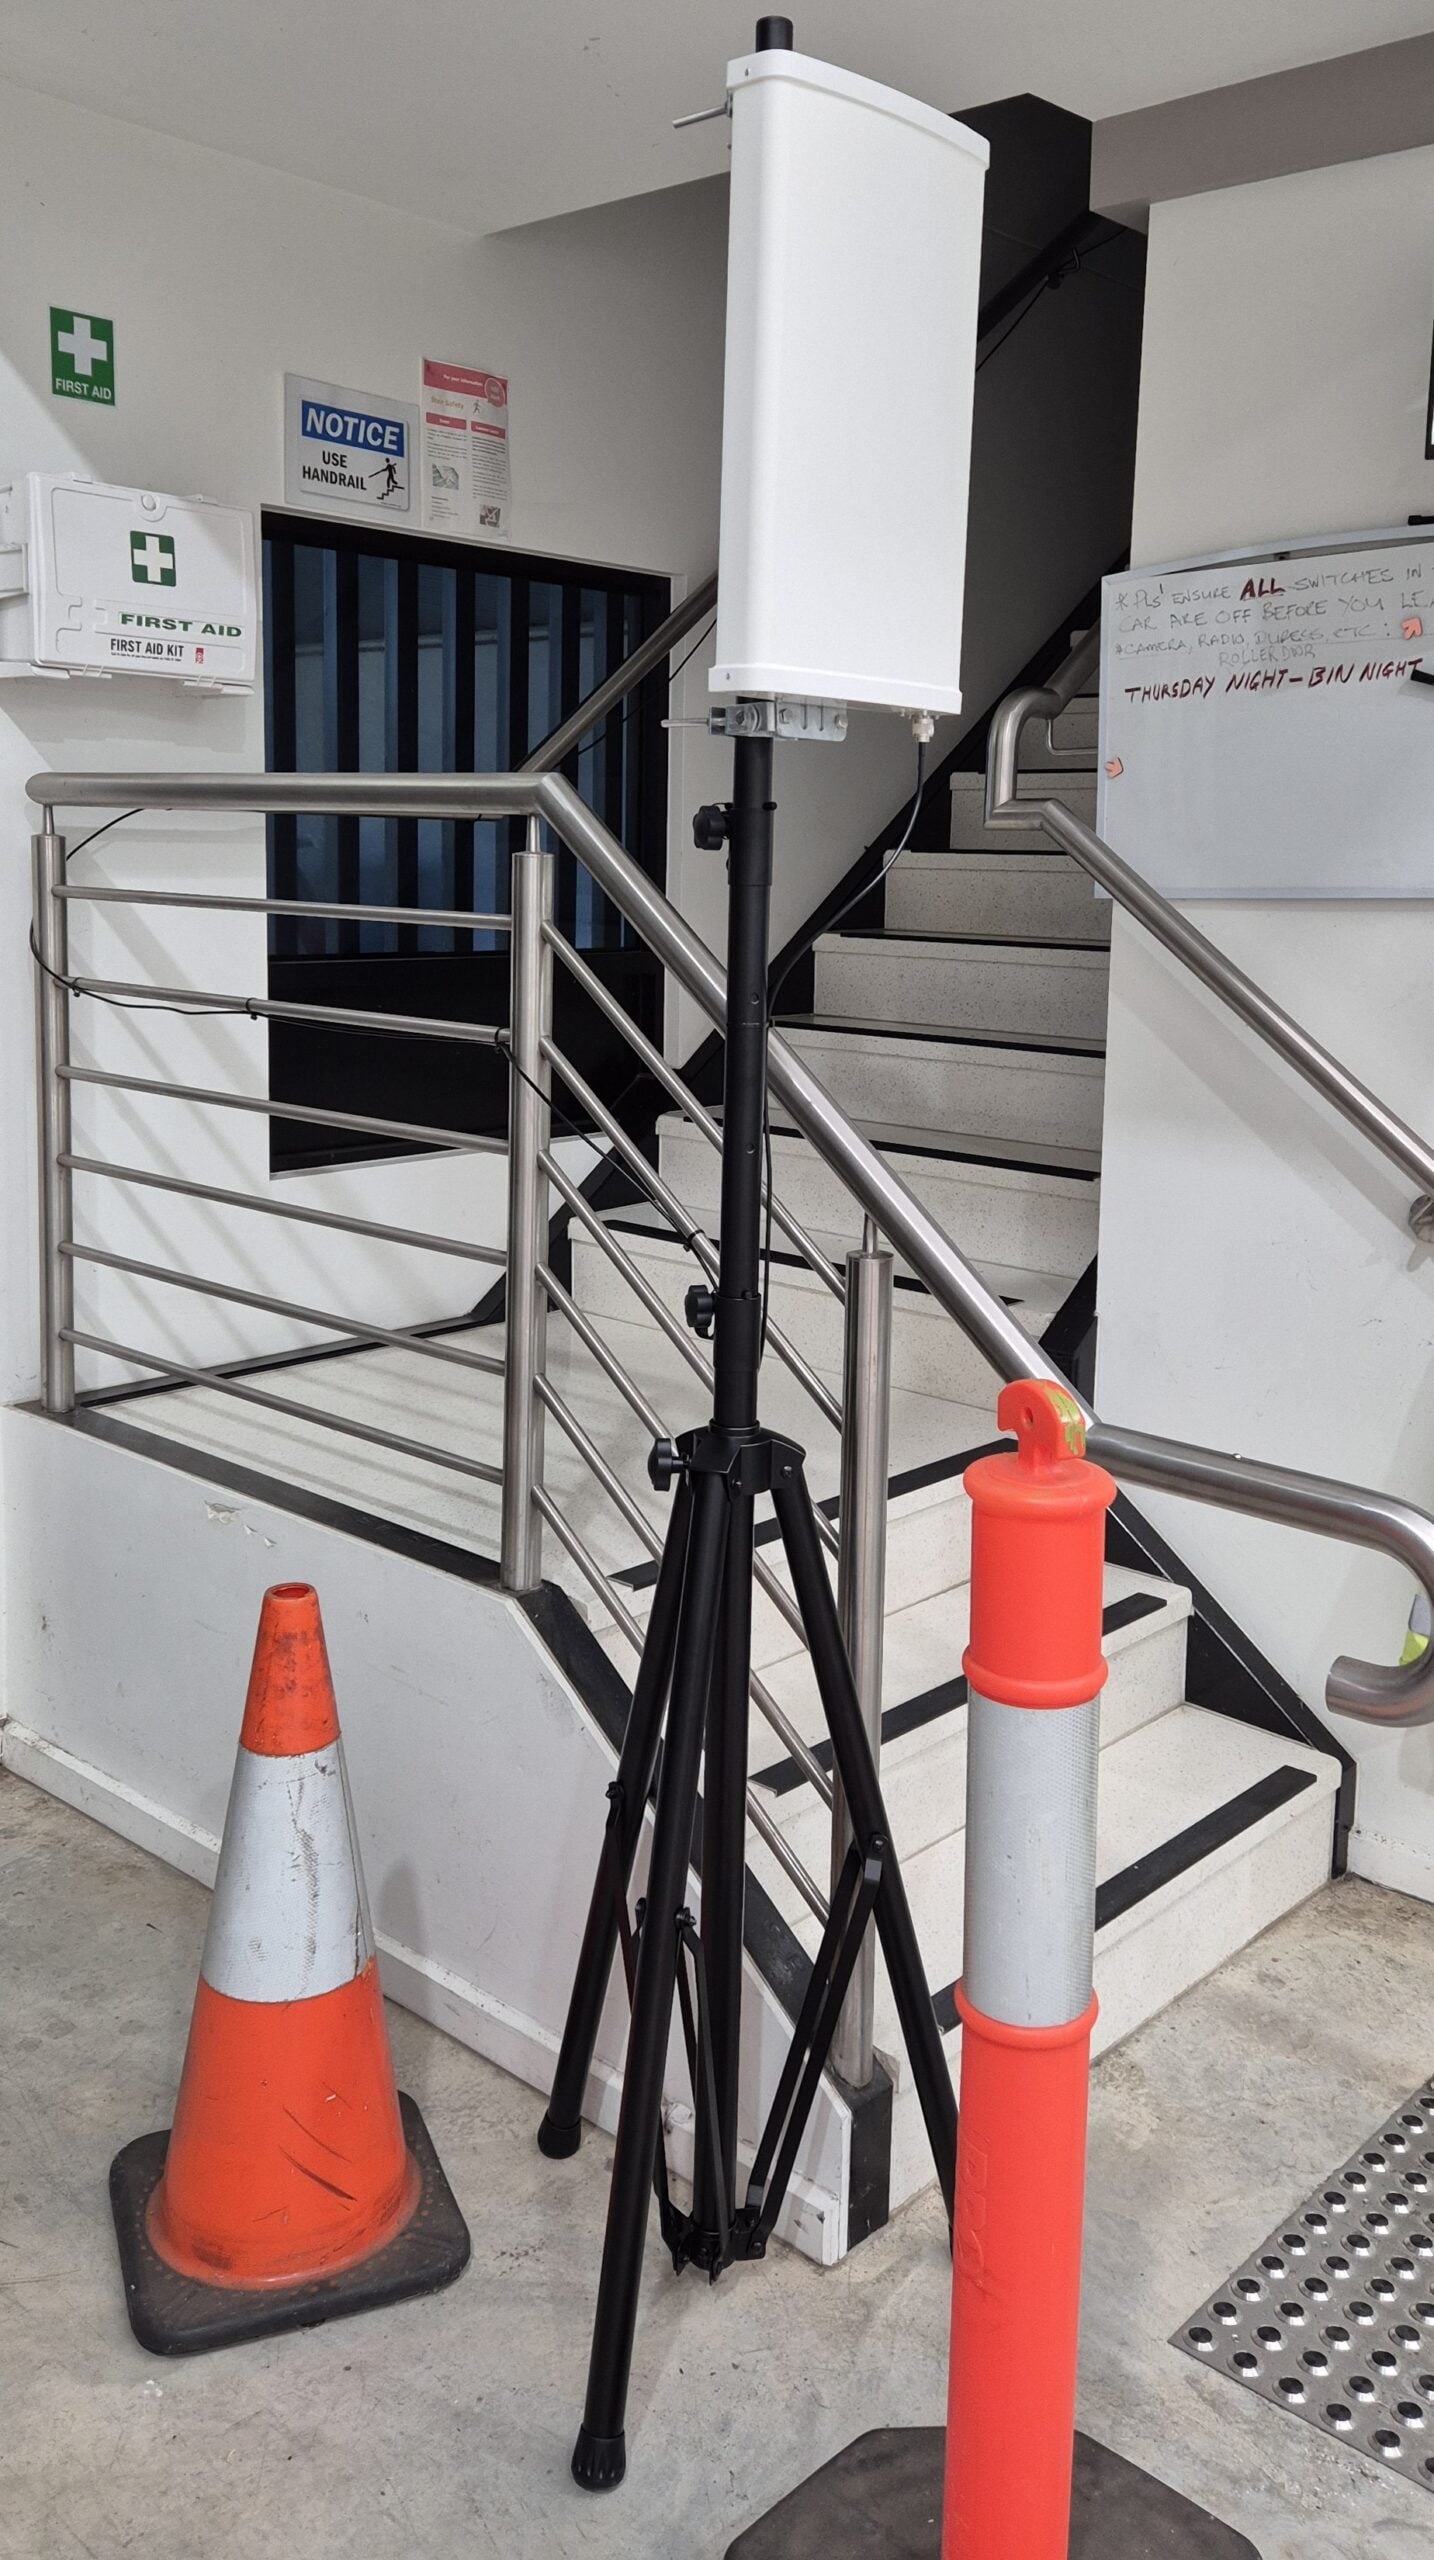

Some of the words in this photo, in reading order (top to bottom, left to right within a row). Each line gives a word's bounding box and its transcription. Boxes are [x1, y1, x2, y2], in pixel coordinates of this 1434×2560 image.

[55, 377, 89, 395] FIRST
[92, 385, 111, 400] AID
[305, 407, 400, 451] NOTICE
[322, 450, 348, 468] USE
[302, 465, 367, 491] HANDRAIL
[1171, 586, 1232, 605] ENSURE
[1239, 577, 1286, 601] ALL
[1288, 567, 1394, 591] SWITCHES
[1406, 563, 1422, 579] IN
[121, 613, 193, 632] FIRST
[201, 623, 242, 637] AID
[1119, 615, 1158, 633] CAR
[1170, 611, 1208, 629] ARE
[1215, 608, 1252, 624] OFF
[1261, 599, 1328, 620] BEFORE
[1338, 595, 1384, 616] YOU
[110, 638, 142, 652] FIRST
[145, 642, 164, 655] AID
[167, 644, 185, 657] KIT
[1125, 675, 1215, 704] THURSDAY
[1308, 662, 1355, 688] BIN
[1359, 657, 1423, 682] NIGHT
